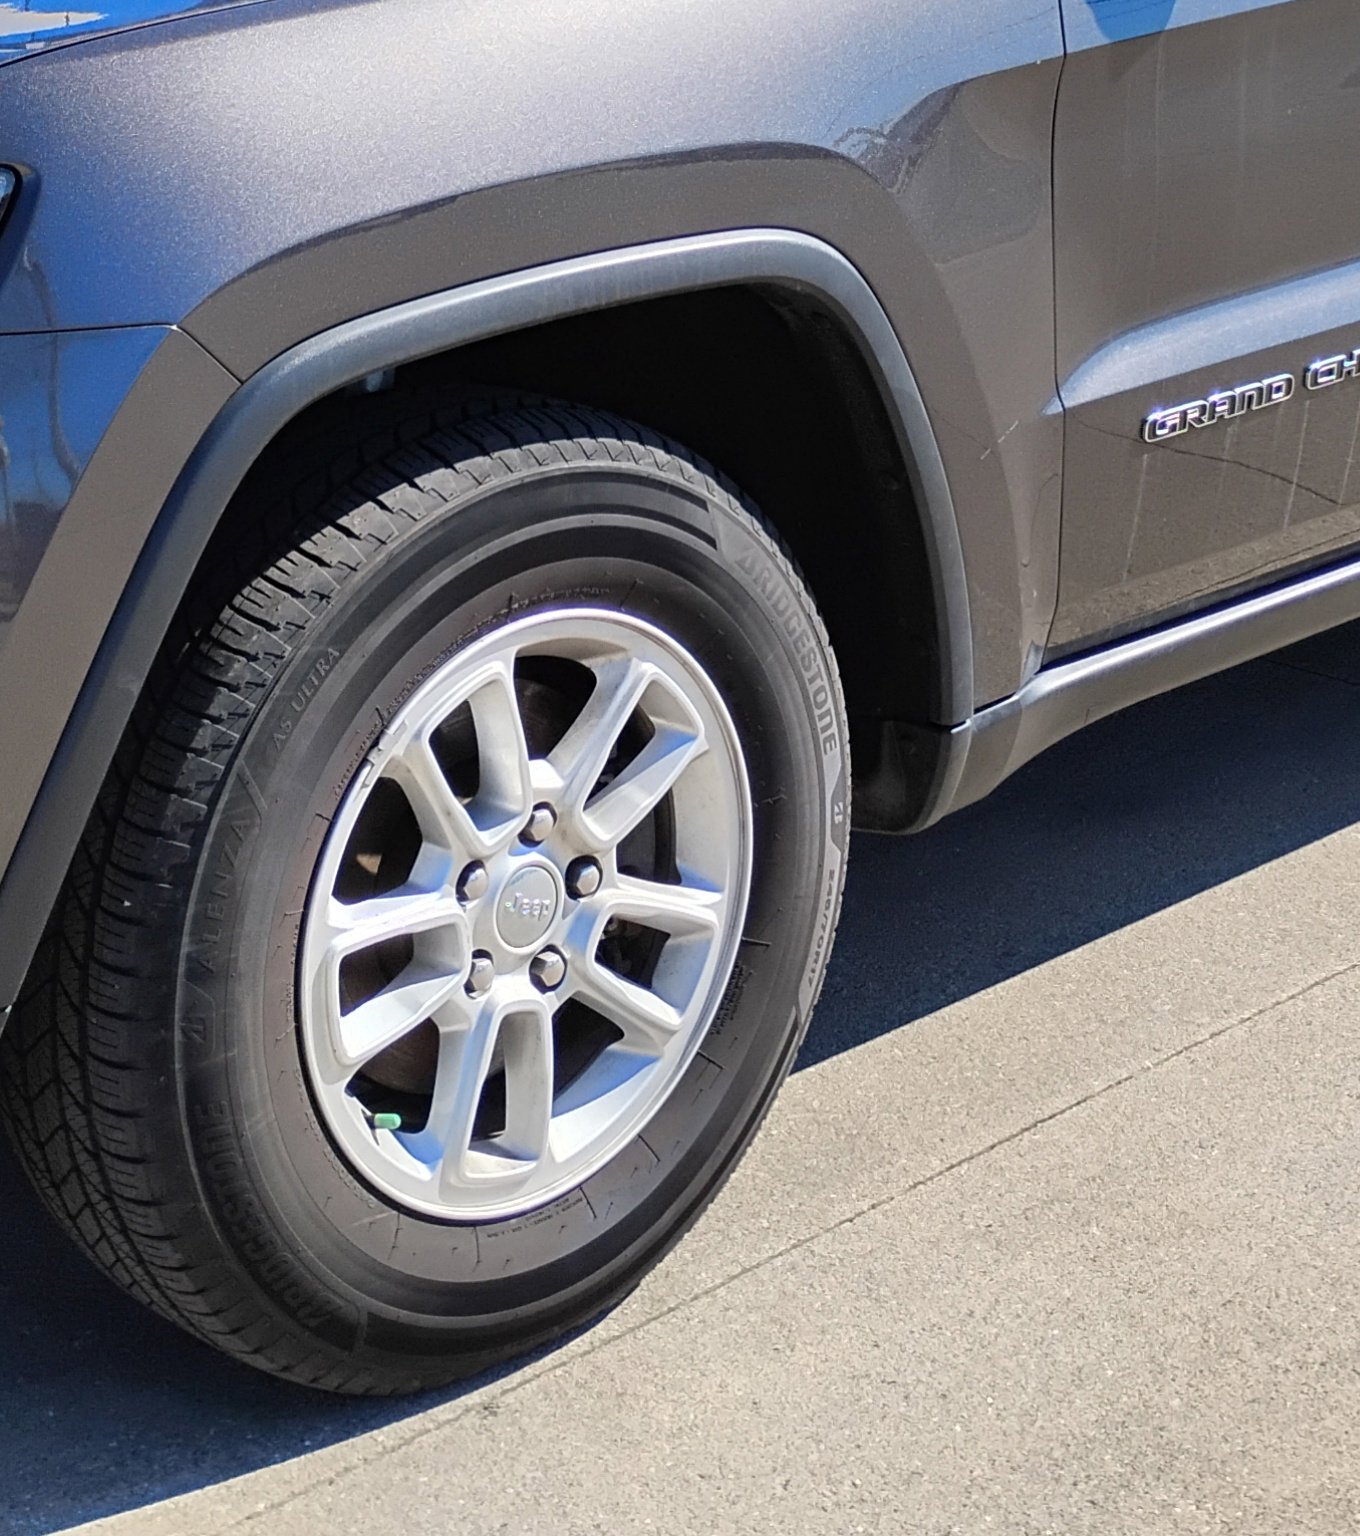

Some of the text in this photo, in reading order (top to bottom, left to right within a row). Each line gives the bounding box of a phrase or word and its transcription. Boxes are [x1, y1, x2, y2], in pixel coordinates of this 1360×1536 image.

[1141, 371, 1296, 444] GRAND
[290, 646, 340, 713] ULTRA
[734, 546, 838, 756] BRIDGESTONE
[198, 814, 249, 975] ALENZA
[504, 891, 552, 922] Jeep
